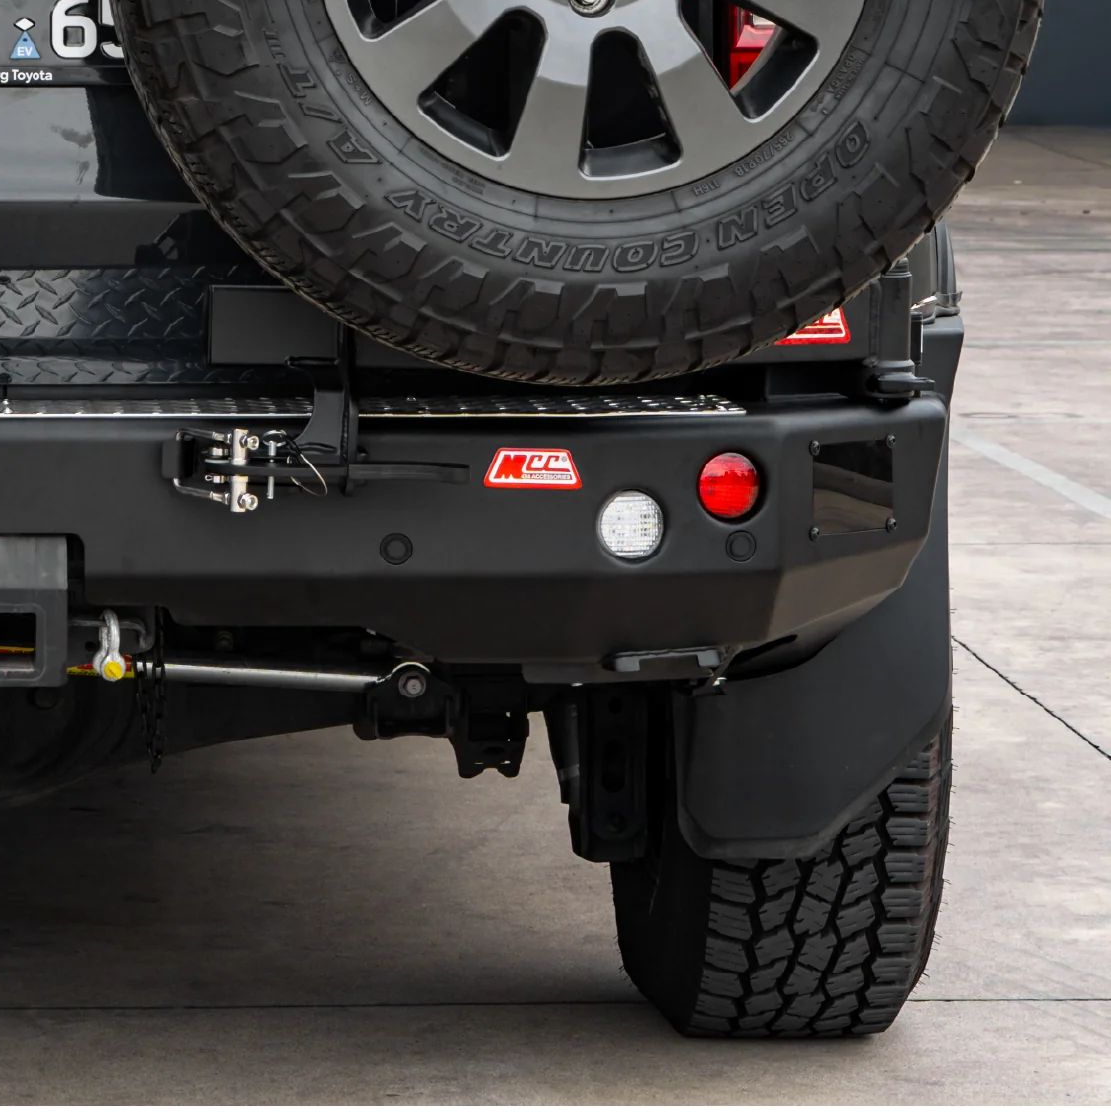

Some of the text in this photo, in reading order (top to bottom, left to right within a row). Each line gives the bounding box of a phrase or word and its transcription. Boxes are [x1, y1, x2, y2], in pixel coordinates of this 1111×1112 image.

[11, 68, 53, 83] Toyota
[17, 47, 33, 56] EV
[276, 63, 383, 165] A/T
[691, 129, 795, 197] 265/70R18 116H
[717, 120, 871, 251] OPEN
[384, 189, 700, 273] COUNTRY
[493, 454, 572, 480] MCC
